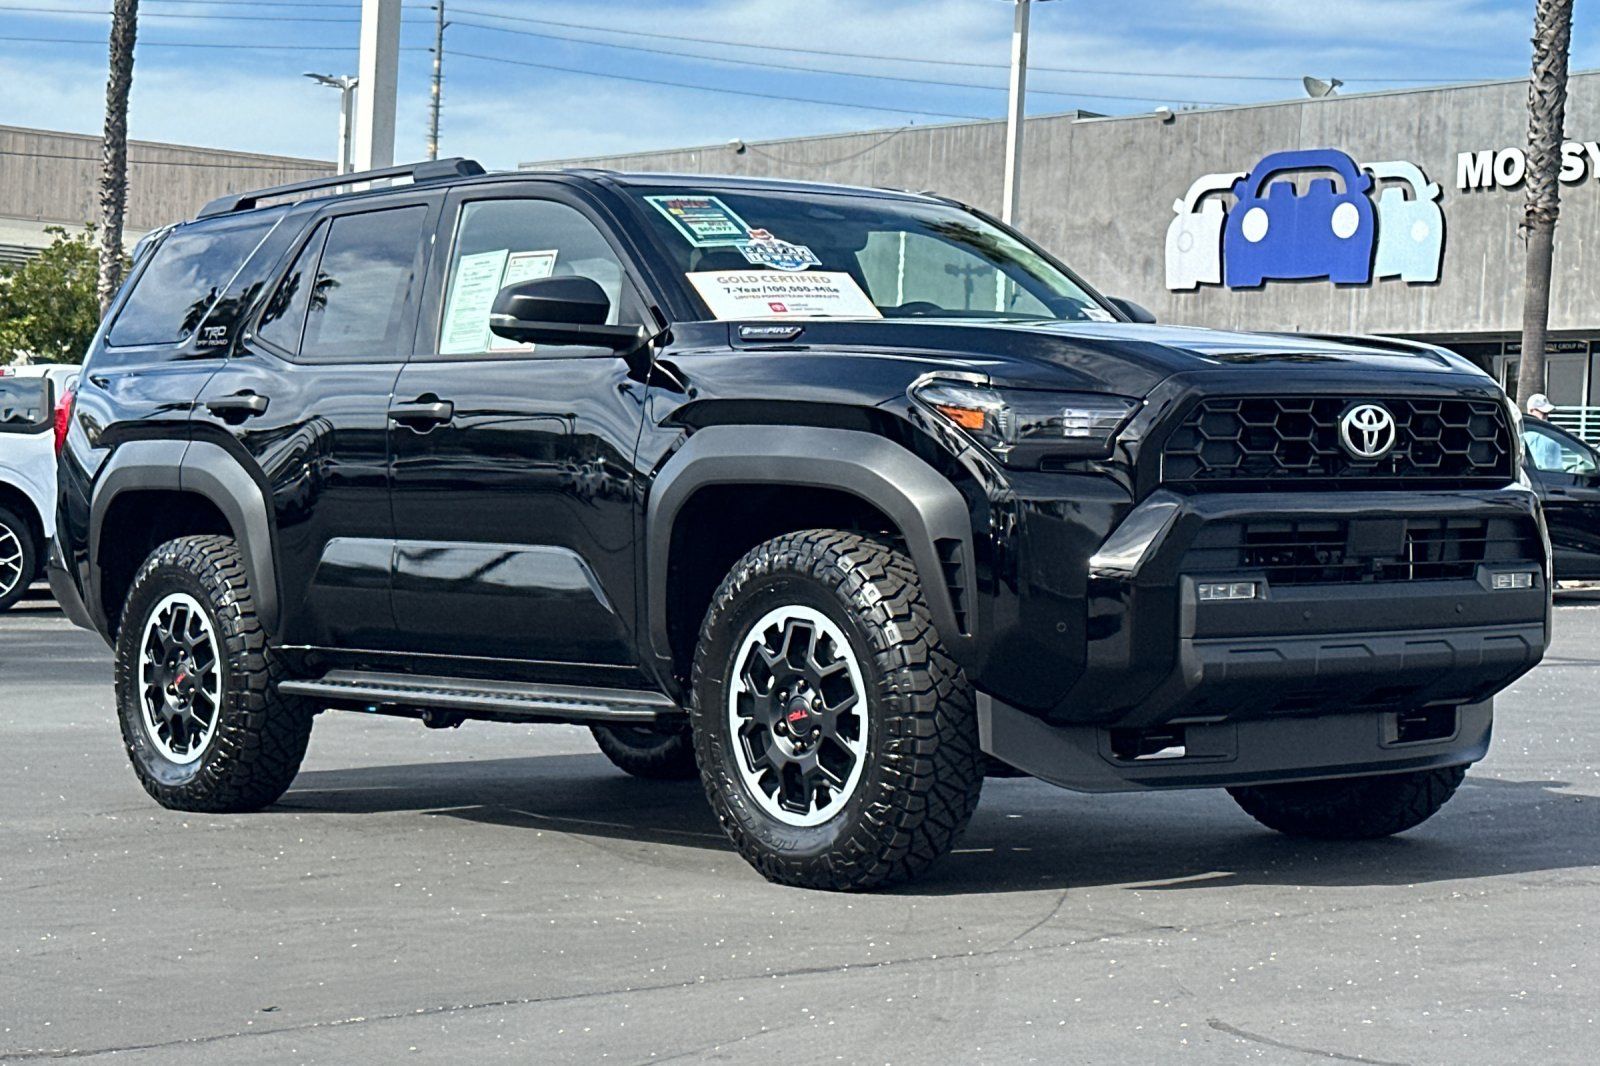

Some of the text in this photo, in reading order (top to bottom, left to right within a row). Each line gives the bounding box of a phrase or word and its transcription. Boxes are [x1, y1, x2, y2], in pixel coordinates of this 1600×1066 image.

[1456, 141, 1600, 189] MOSY
[717, 275, 832, 284] GOLD CERTIFIED
[204, 325, 228, 340] TRD
